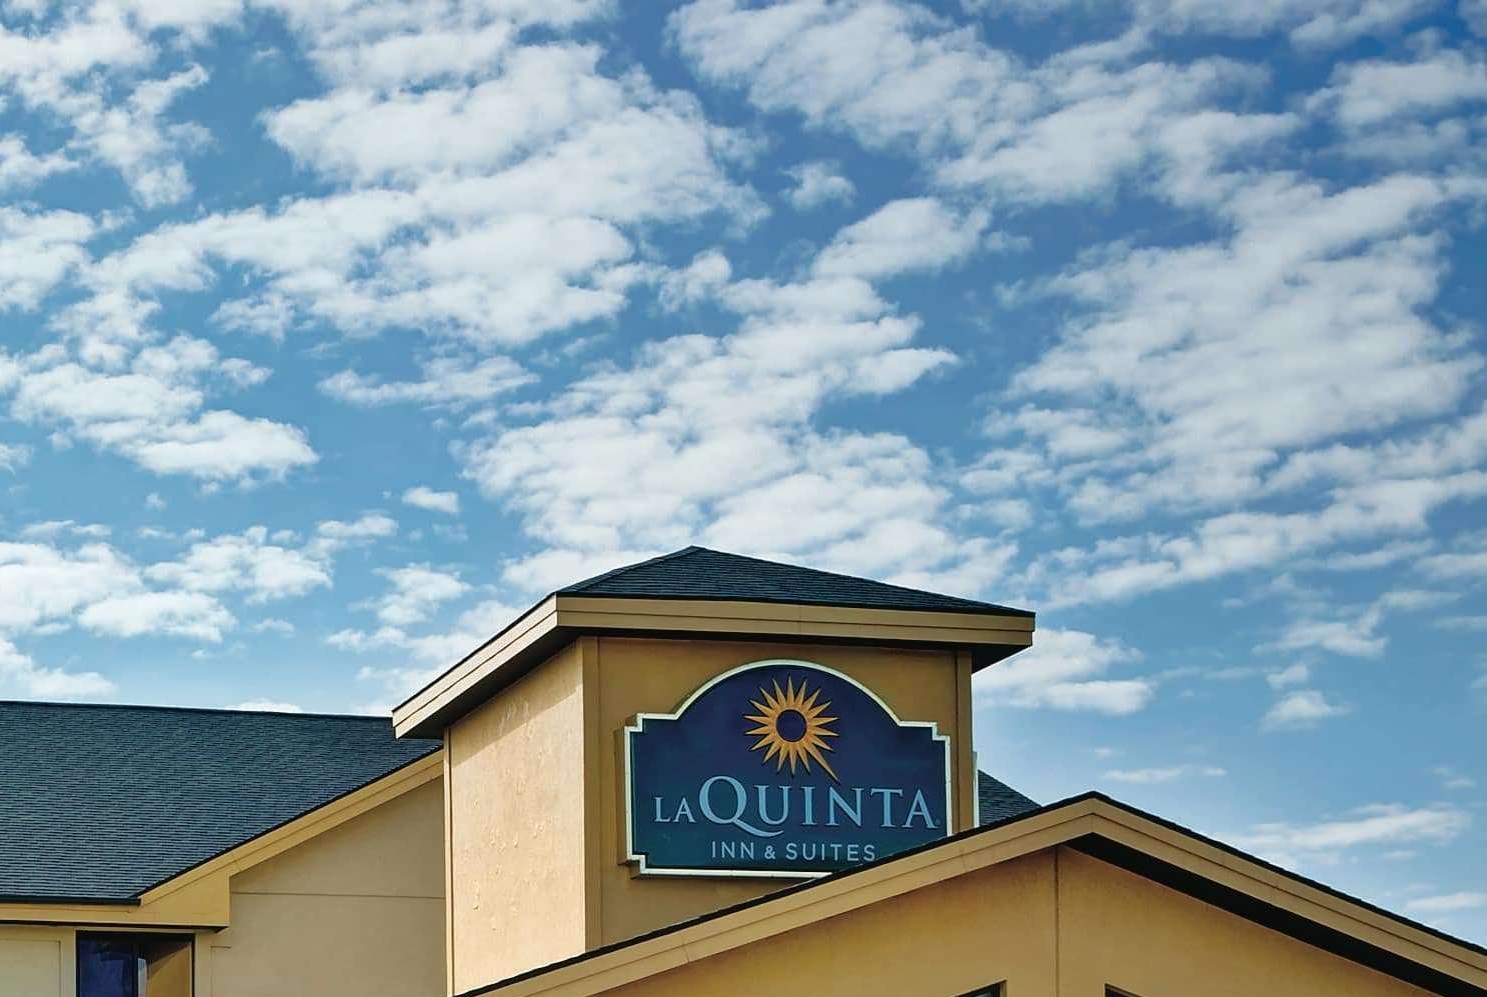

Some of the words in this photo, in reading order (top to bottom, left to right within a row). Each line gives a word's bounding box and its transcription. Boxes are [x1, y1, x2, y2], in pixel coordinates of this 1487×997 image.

[653, 796, 697, 823] LA
[698, 775, 938, 838] QUINTA
[711, 841, 754, 860] INN
[764, 845, 776, 860] &
[785, 842, 875, 862] SUITES
